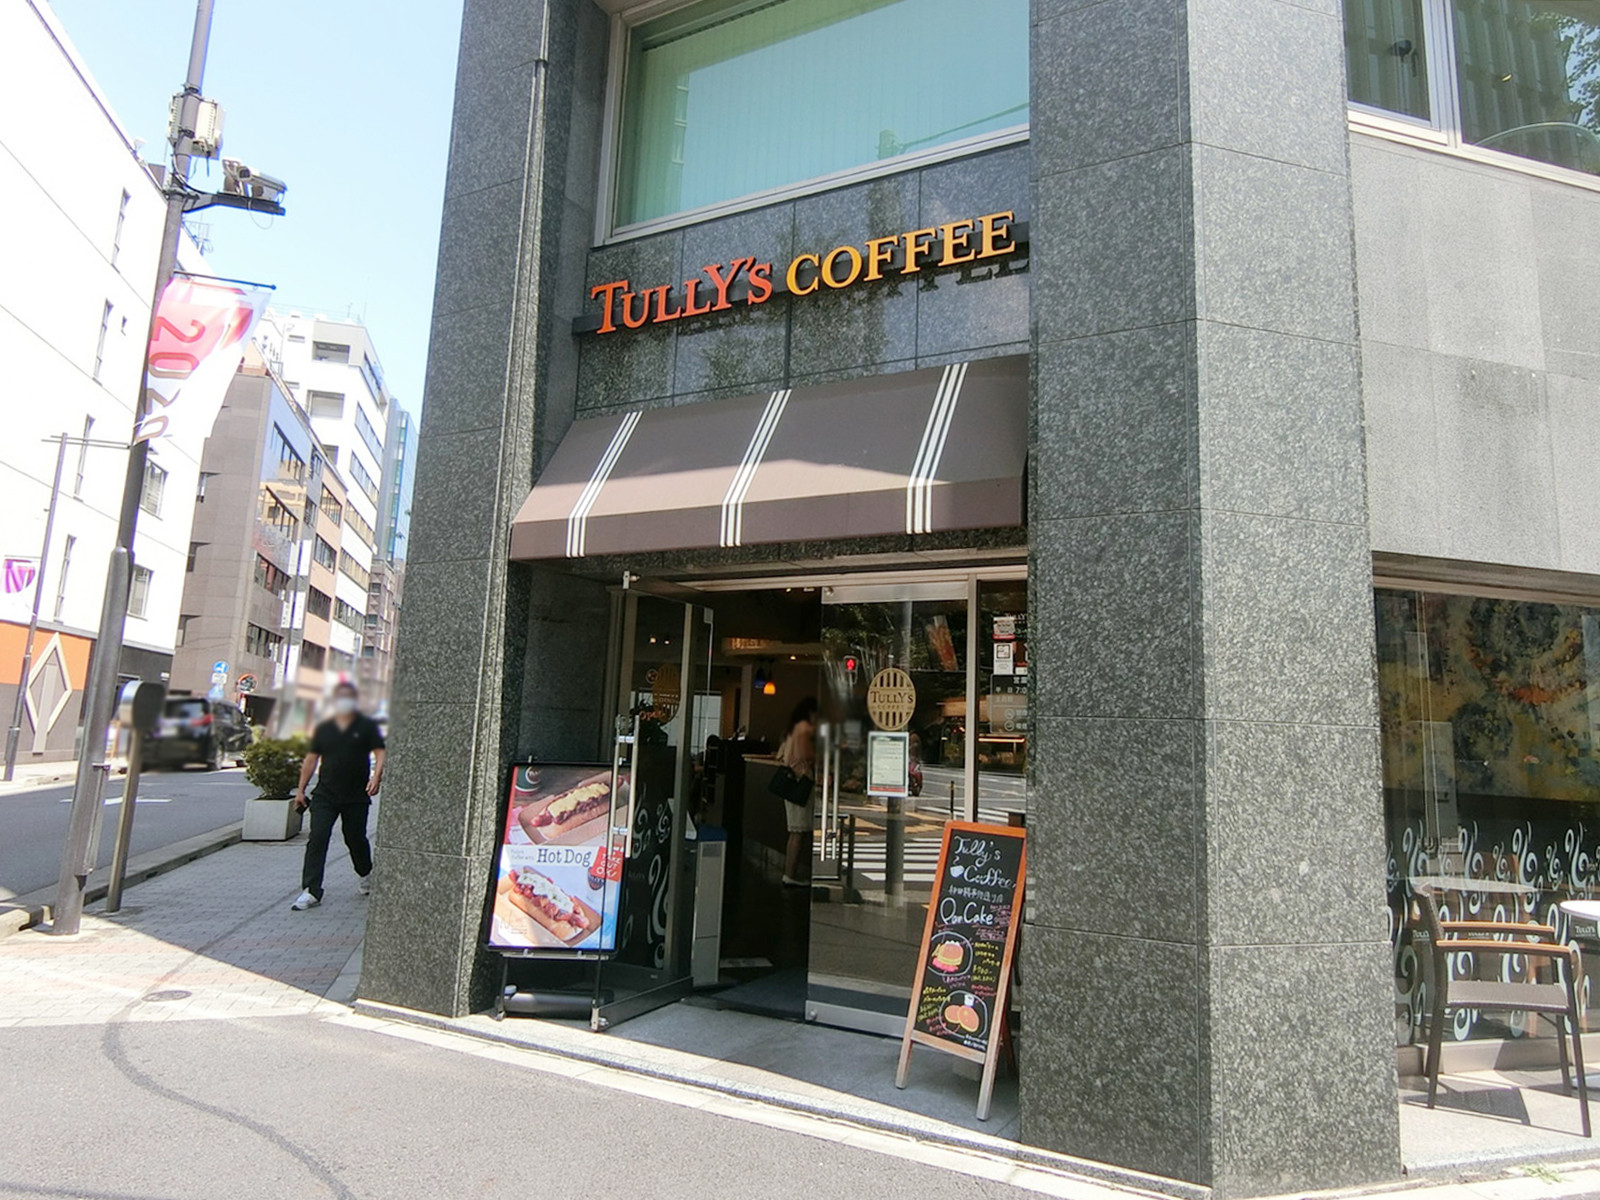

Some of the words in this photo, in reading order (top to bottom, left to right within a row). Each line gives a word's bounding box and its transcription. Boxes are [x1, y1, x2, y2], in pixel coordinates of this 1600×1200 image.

[785, 210, 1016, 296] COFFEE
[537, 848, 562, 864] Hot
[565, 849, 592, 868] Dog
[953, 835, 1001, 867] Tully's
